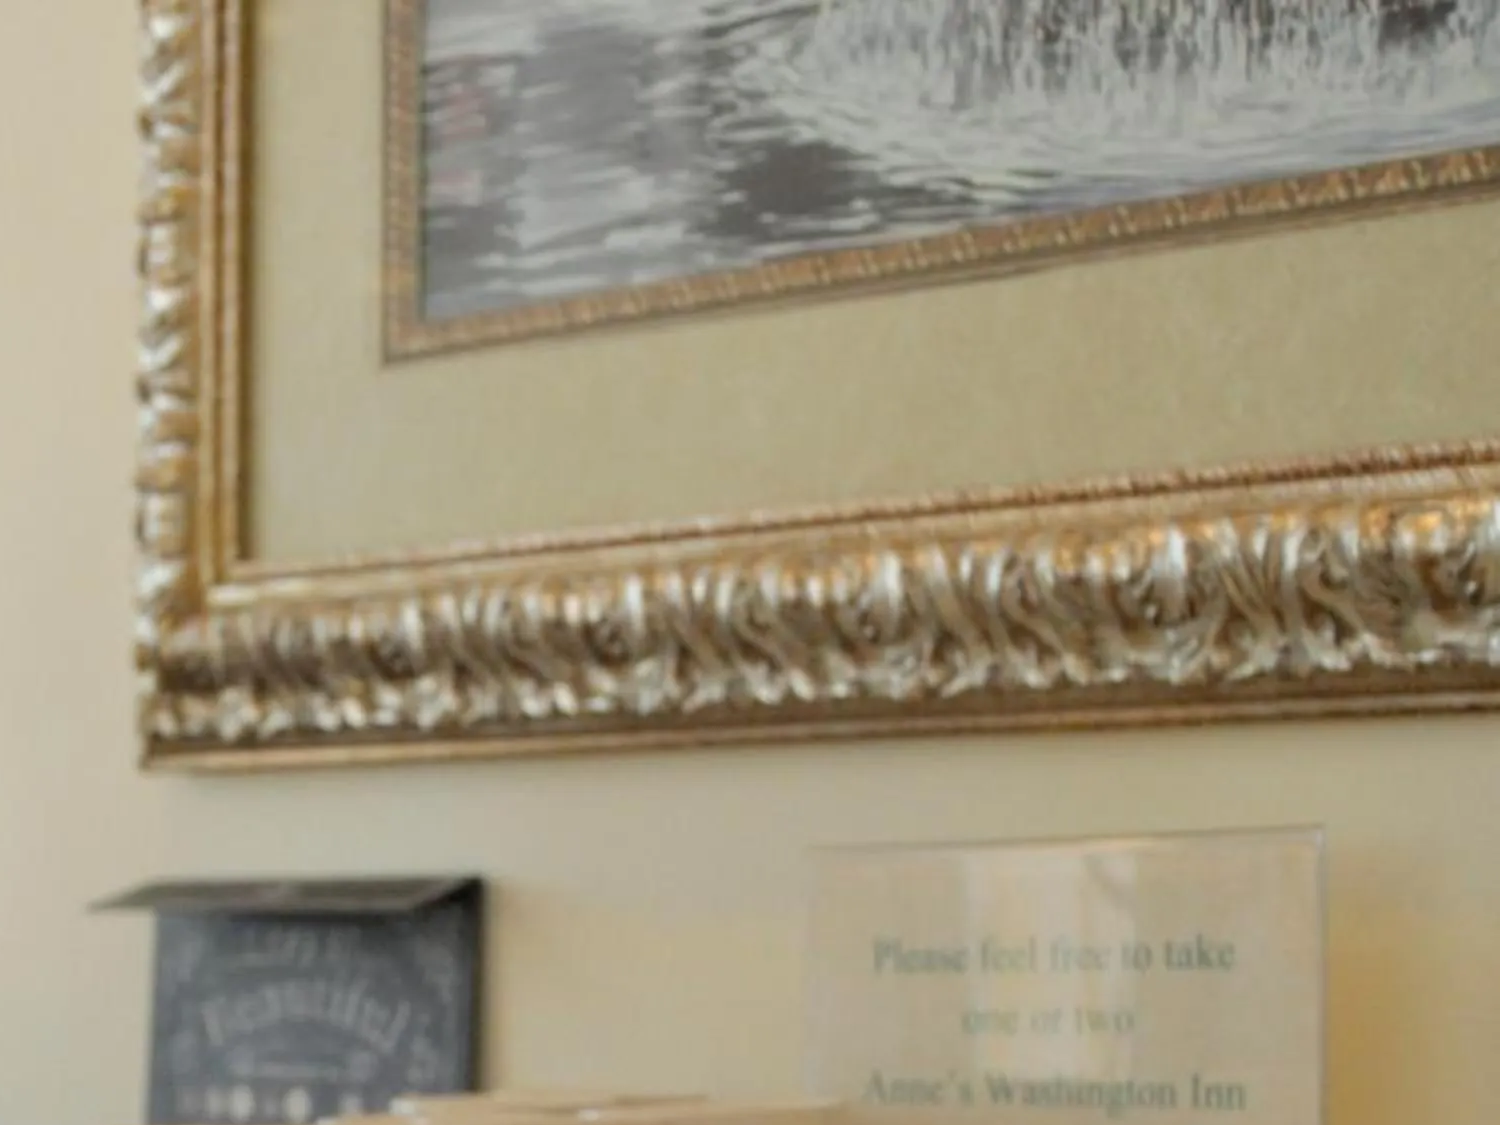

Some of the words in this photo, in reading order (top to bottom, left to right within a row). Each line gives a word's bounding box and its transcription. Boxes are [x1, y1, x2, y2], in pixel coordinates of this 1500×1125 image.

[872, 935, 968, 976] Please
[980, 936, 1038, 974] feel
[1049, 936, 1111, 974] free
[1120, 939, 1153, 972] to
[1163, 932, 1236, 972] take
[960, 1009, 1018, 1036] one
[1074, 1006, 1136, 1035] two
[861, 1067, 975, 1108] Anne's
[983, 1068, 1177, 1119] Washington
[1191, 1072, 1248, 1111] Inn
